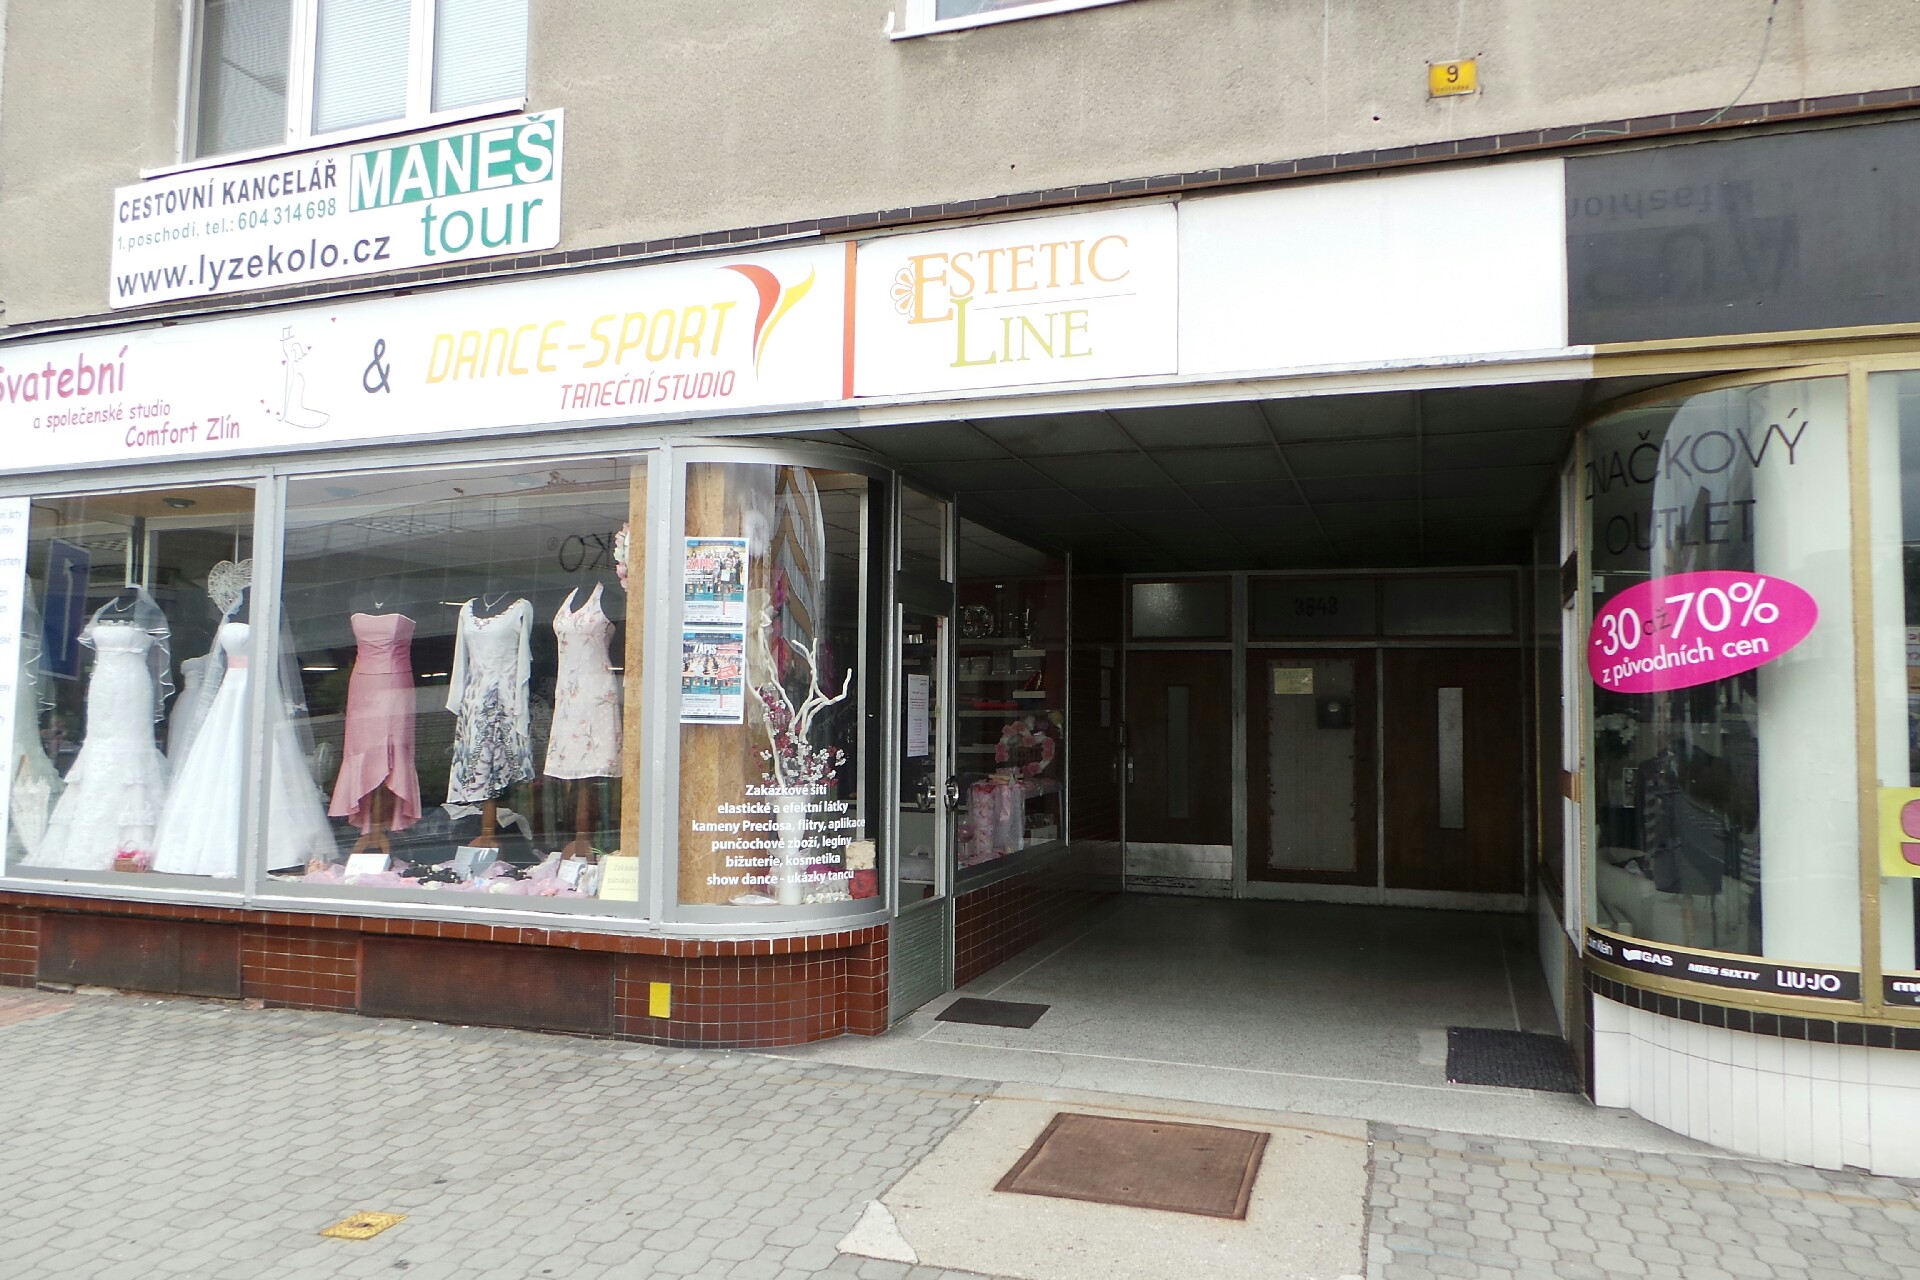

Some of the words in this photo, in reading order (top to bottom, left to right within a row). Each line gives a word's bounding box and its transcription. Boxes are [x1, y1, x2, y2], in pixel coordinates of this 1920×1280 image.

[1447, 64, 1459, 83] 9
[350, 114, 553, 212] MANEŠ
[119, 178, 214, 223] CESTOVNÍ
[222, 158, 337, 205] KANCELÁŘ
[238, 209, 269, 230] 604
[273, 203, 302, 225] 314
[306, 197, 336, 220] 698
[420, 198, 544, 257] tour
[117, 235, 391, 297] www.lyzekolo.cz
[907, 234, 1131, 325] ESTETIC
[425, 301, 737, 384] DANCE-SPORT
[950, 296, 1093, 368] LINE
[0, 344, 129, 403] vatební
[363, 338, 391, 394] &
[561, 370, 655, 410] TANEČNÍ
[654, 369, 736, 403] STUDIO
[33, 417, 41, 429] a
[46, 402, 123, 433] společenské
[129, 399, 171, 420] studio
[125, 421, 198, 447] Comfort
[206, 414, 240, 441] Zlín
[1605, 499, 1756, 556] OUTLET
[1665, 578, 1780, 639] 70%
[1602, 668, 1611, 684] z
[1613, 637, 1714, 686] původních
[1722, 636, 1769, 658] cen
[717, 802, 771, 814] elastické
[782, 801, 822, 814] efektní
[824, 800, 849, 814] látky
[745, 784, 808, 796] Zakázkové
[810, 783, 827, 795] šití
[692, 820, 739, 834] kameny
[742, 820, 795, 834] Preciosa,
[827, 817, 866, 832] aplikace
[711, 837, 785, 852] punčochové
[787, 836, 820, 849] zboží,
[822, 834, 852, 849] legíny
[707, 874, 739, 886] show
[742, 872, 778, 886] dance
[787, 871, 826, 885] ukázky
[726, 855, 783, 870] bižuterie,
[785, 853, 841, 867] kosmetika
[1642, 951, 1674, 967] GAS
[1720, 967, 1761, 981] SIXTY
